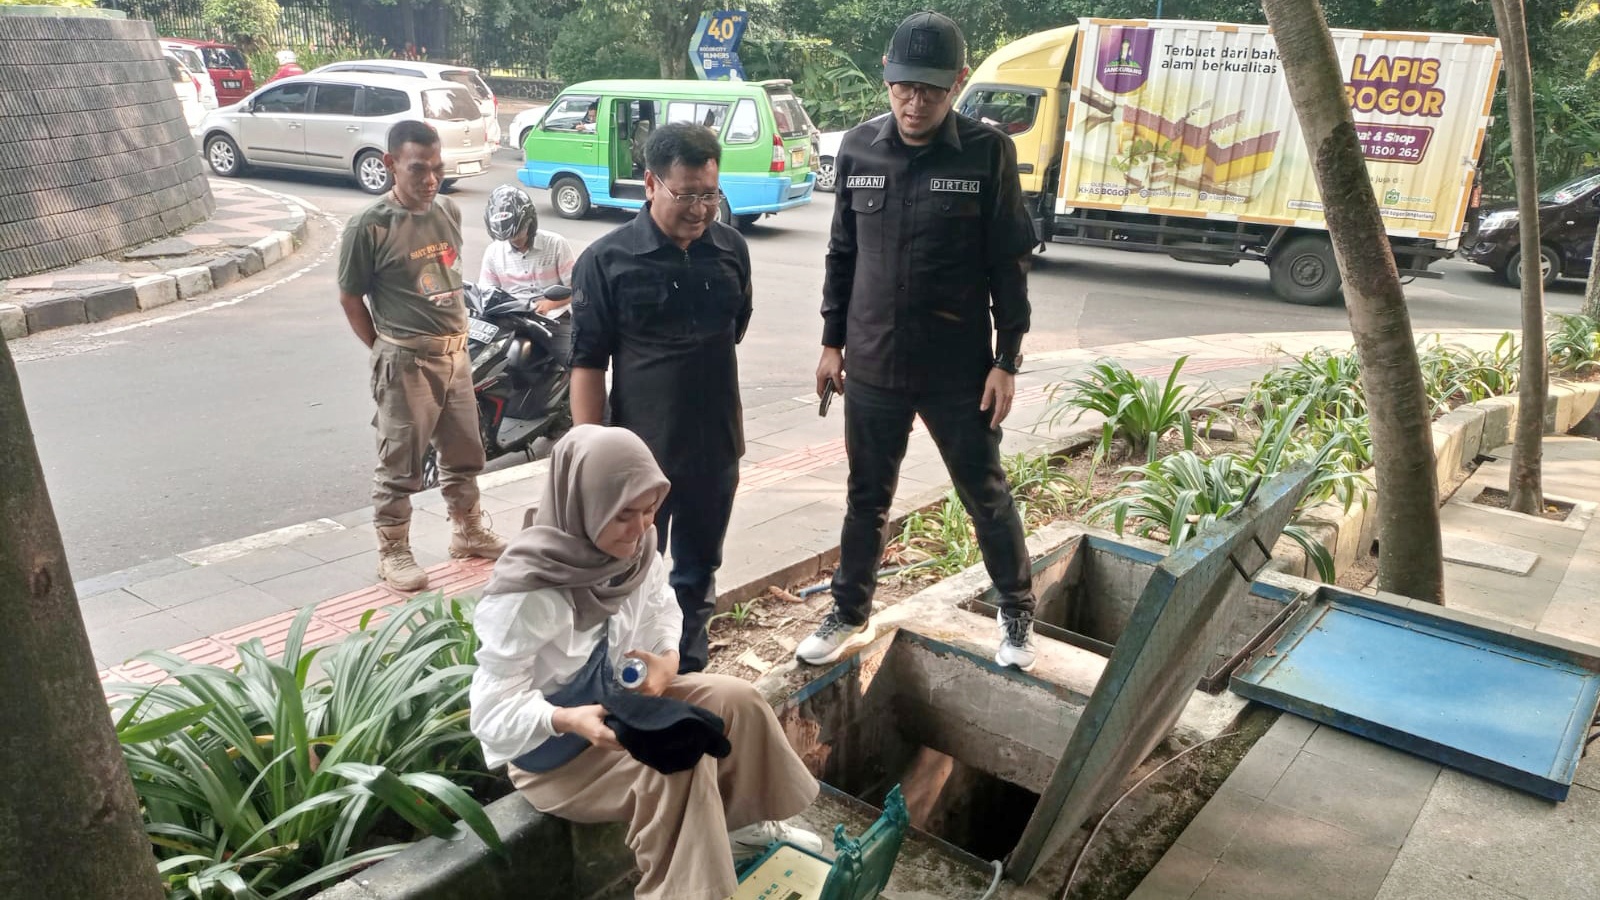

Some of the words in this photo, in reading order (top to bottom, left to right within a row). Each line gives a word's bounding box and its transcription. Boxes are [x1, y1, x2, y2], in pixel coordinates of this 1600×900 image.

[1164, 44, 1216, 58] Terbuat
[1221, 46, 1248, 59] dari
[1161, 58, 1197, 71] alami
[1202, 60, 1278, 74] berkualitas
[1351, 57, 1440, 85] LAPIS
[1373, 131, 1383, 142] &
[1384, 132, 1416, 145] Shop
[1371, 144, 1396, 156] 1500
[1398, 147, 1420, 158] 262
[848, 177, 884, 187] ARDANI
[933, 180, 976, 191] DIRTEK
[1101, 187, 1130, 197] BOGOR
